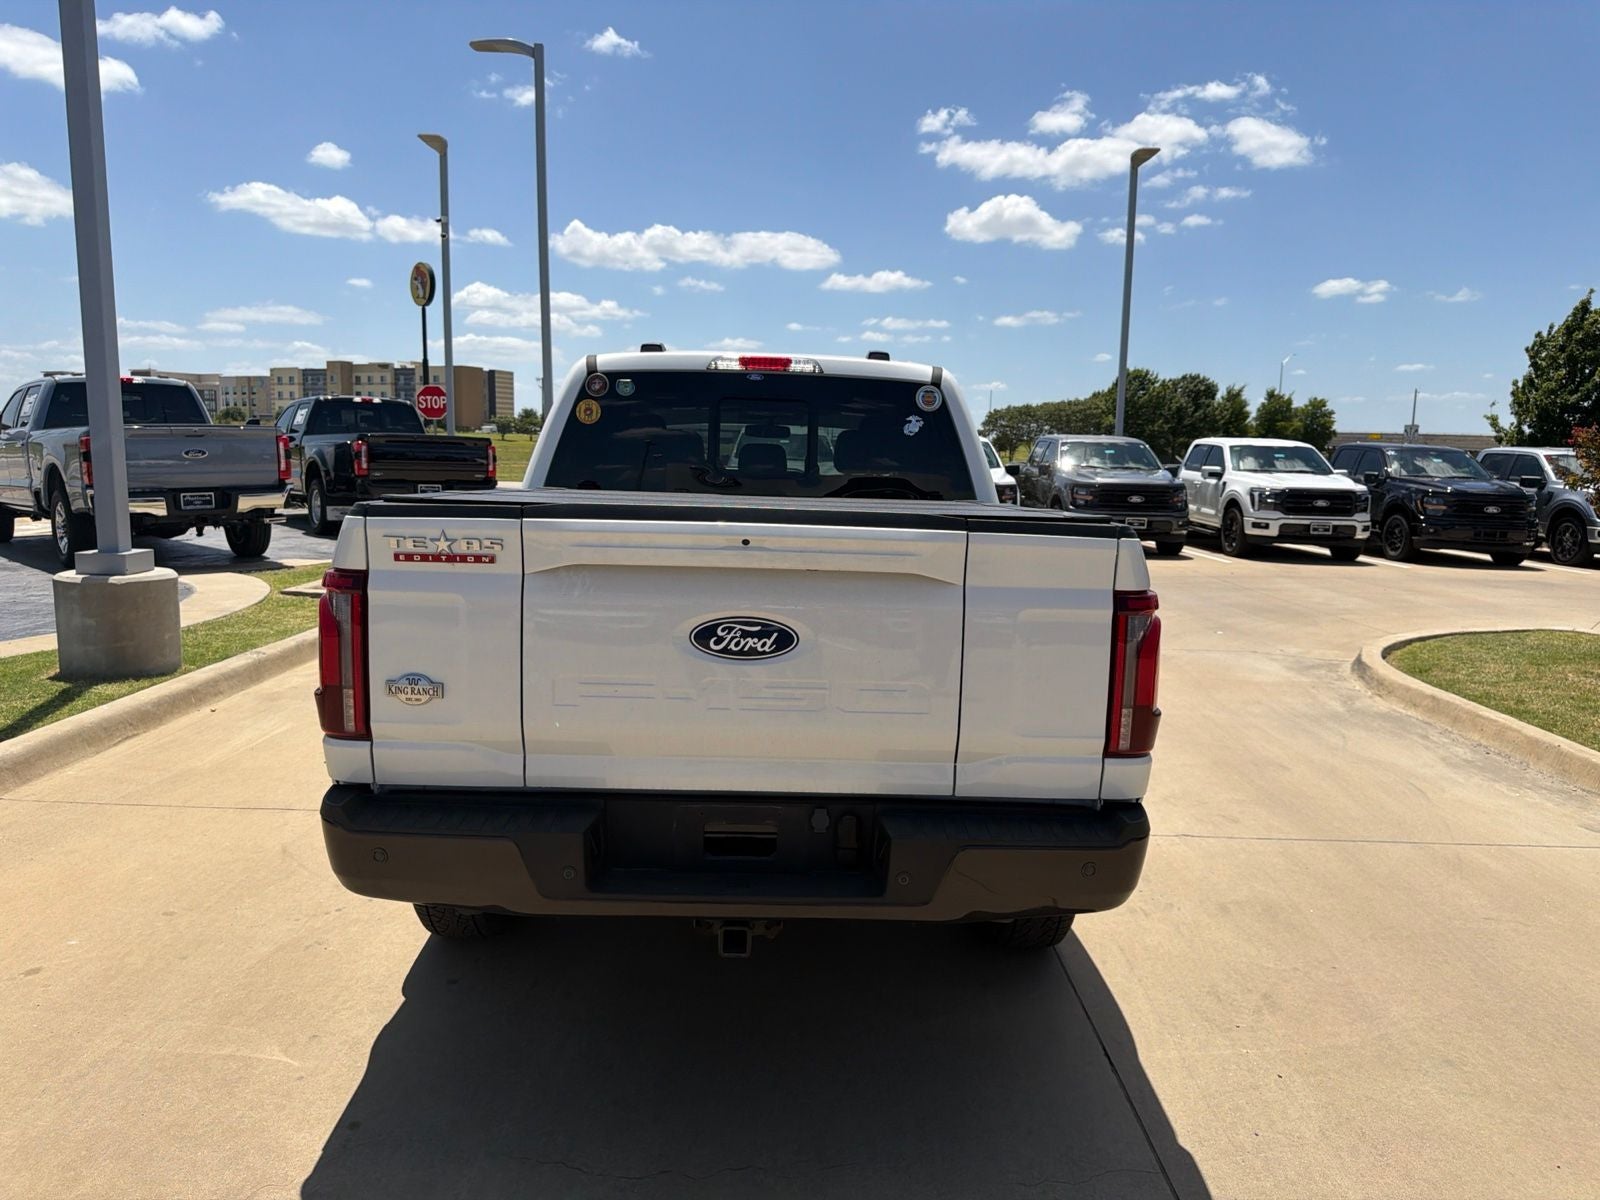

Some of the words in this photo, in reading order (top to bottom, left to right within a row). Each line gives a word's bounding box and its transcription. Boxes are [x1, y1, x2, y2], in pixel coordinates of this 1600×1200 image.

[418, 395, 447, 409] STOP
[399, 555, 490, 563] EDITION
[709, 623, 778, 652] Ford
[388, 684, 408, 696] KING
[410, 686, 439, 697] RANCH
